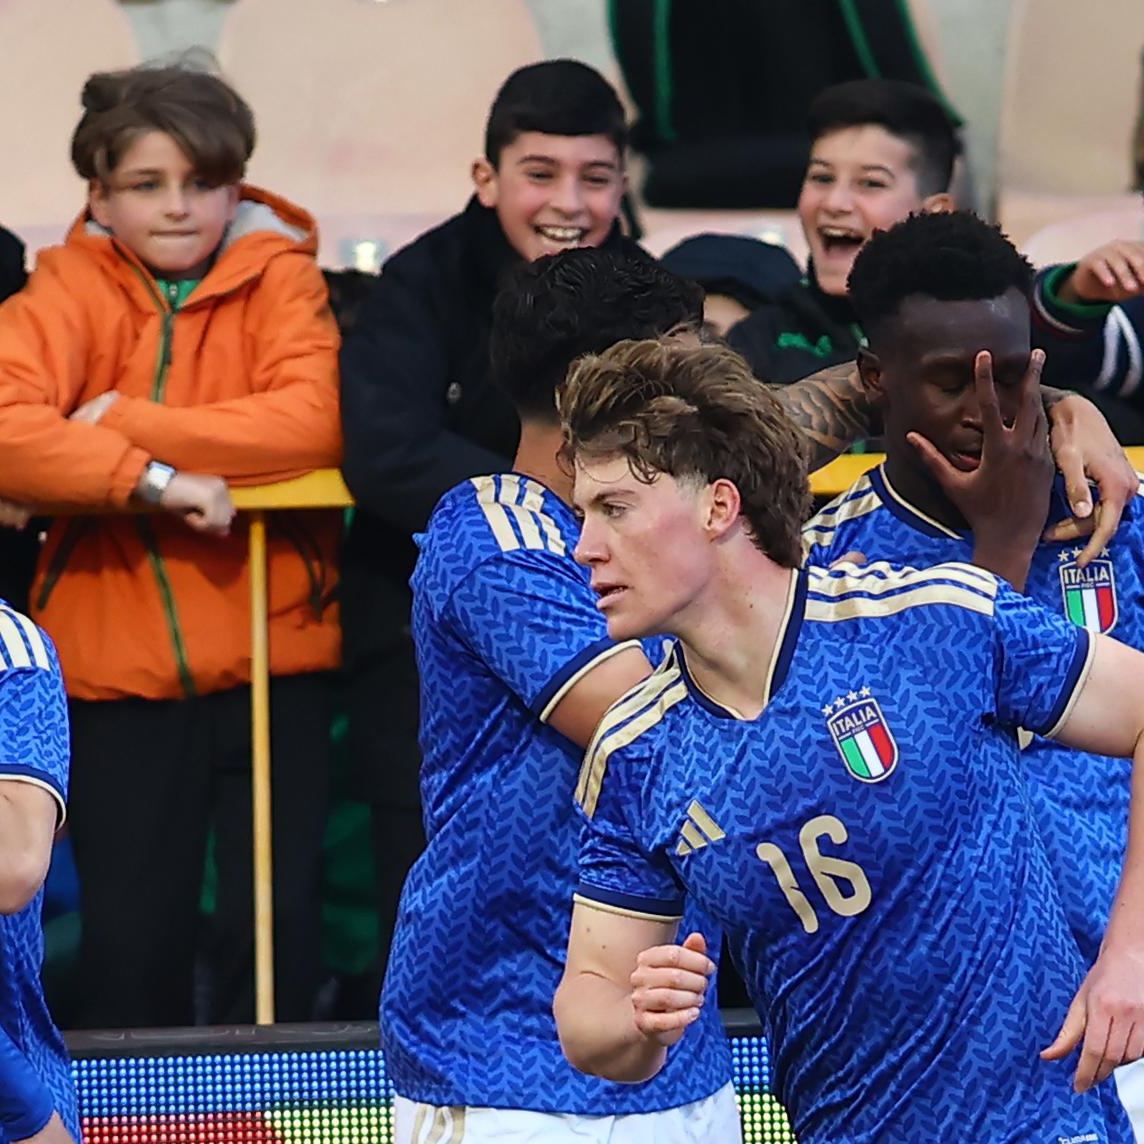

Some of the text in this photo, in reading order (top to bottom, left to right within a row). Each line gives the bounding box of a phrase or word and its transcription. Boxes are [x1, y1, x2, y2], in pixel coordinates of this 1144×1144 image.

[1063, 566, 1110, 584] ITALIA
[832, 705, 878, 737] ITALIA
[756, 814, 872, 933] 16
